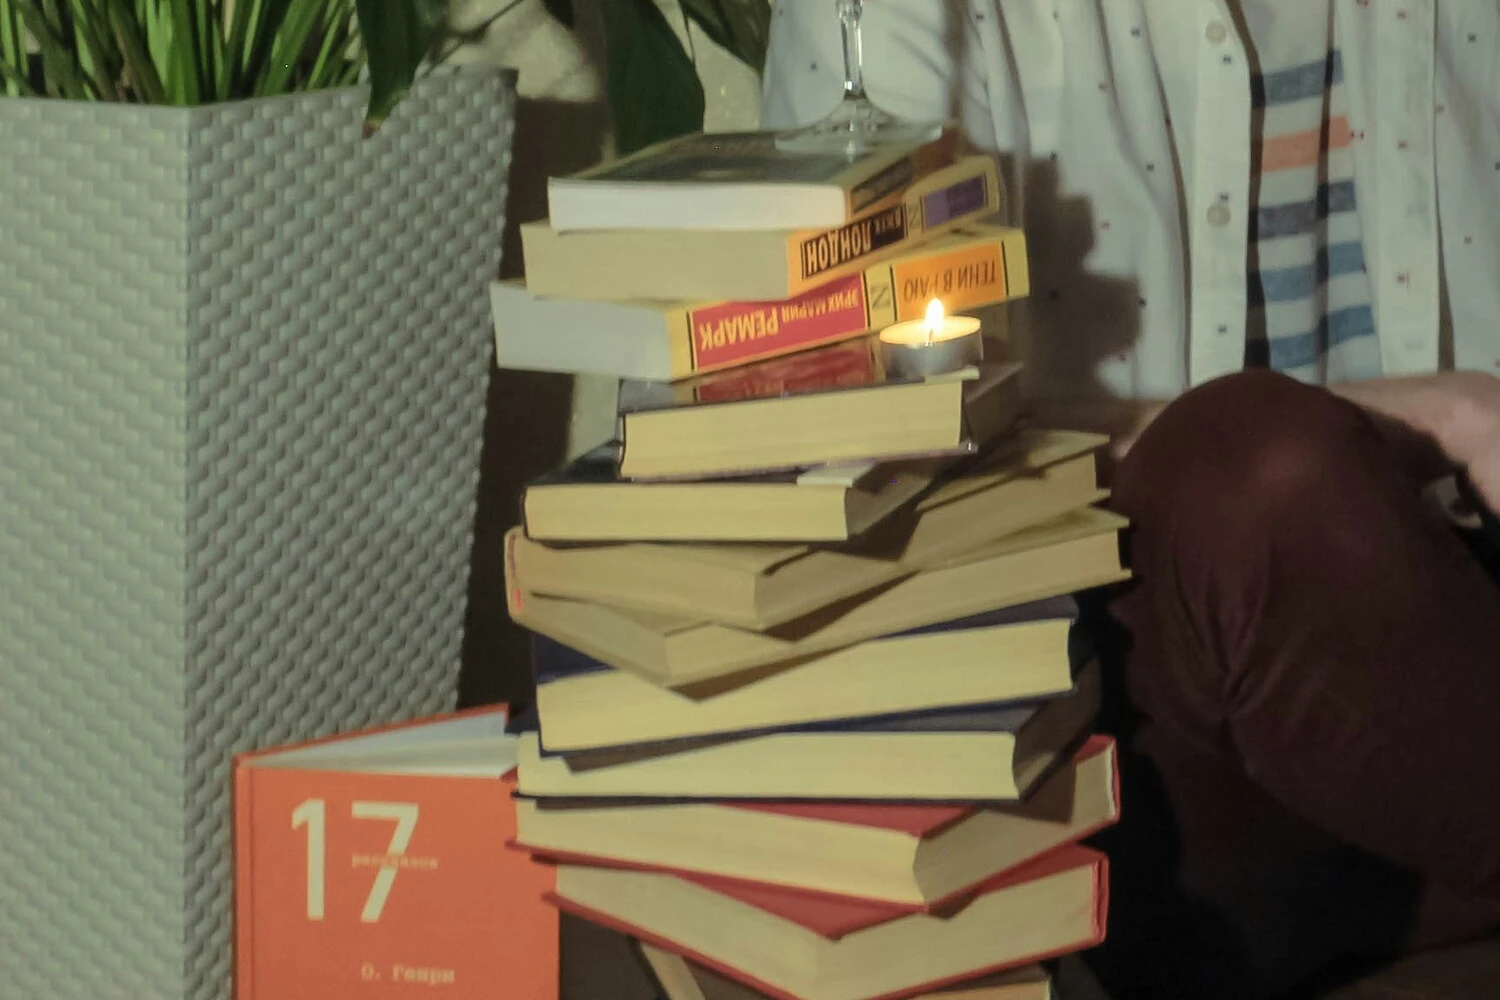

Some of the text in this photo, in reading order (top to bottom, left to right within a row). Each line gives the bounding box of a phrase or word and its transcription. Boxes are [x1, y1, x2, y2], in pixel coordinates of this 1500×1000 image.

[805, 220, 872, 273] ЛОНДОН
[943, 269, 953, 294] В
[958, 259, 996, 292] ТЕНИ
[698, 289, 859, 351] ЭРИХ МАРИЯ РЕМАРК
[291, 797, 420, 923] 17
[392, 962, 455, 987] Генри
